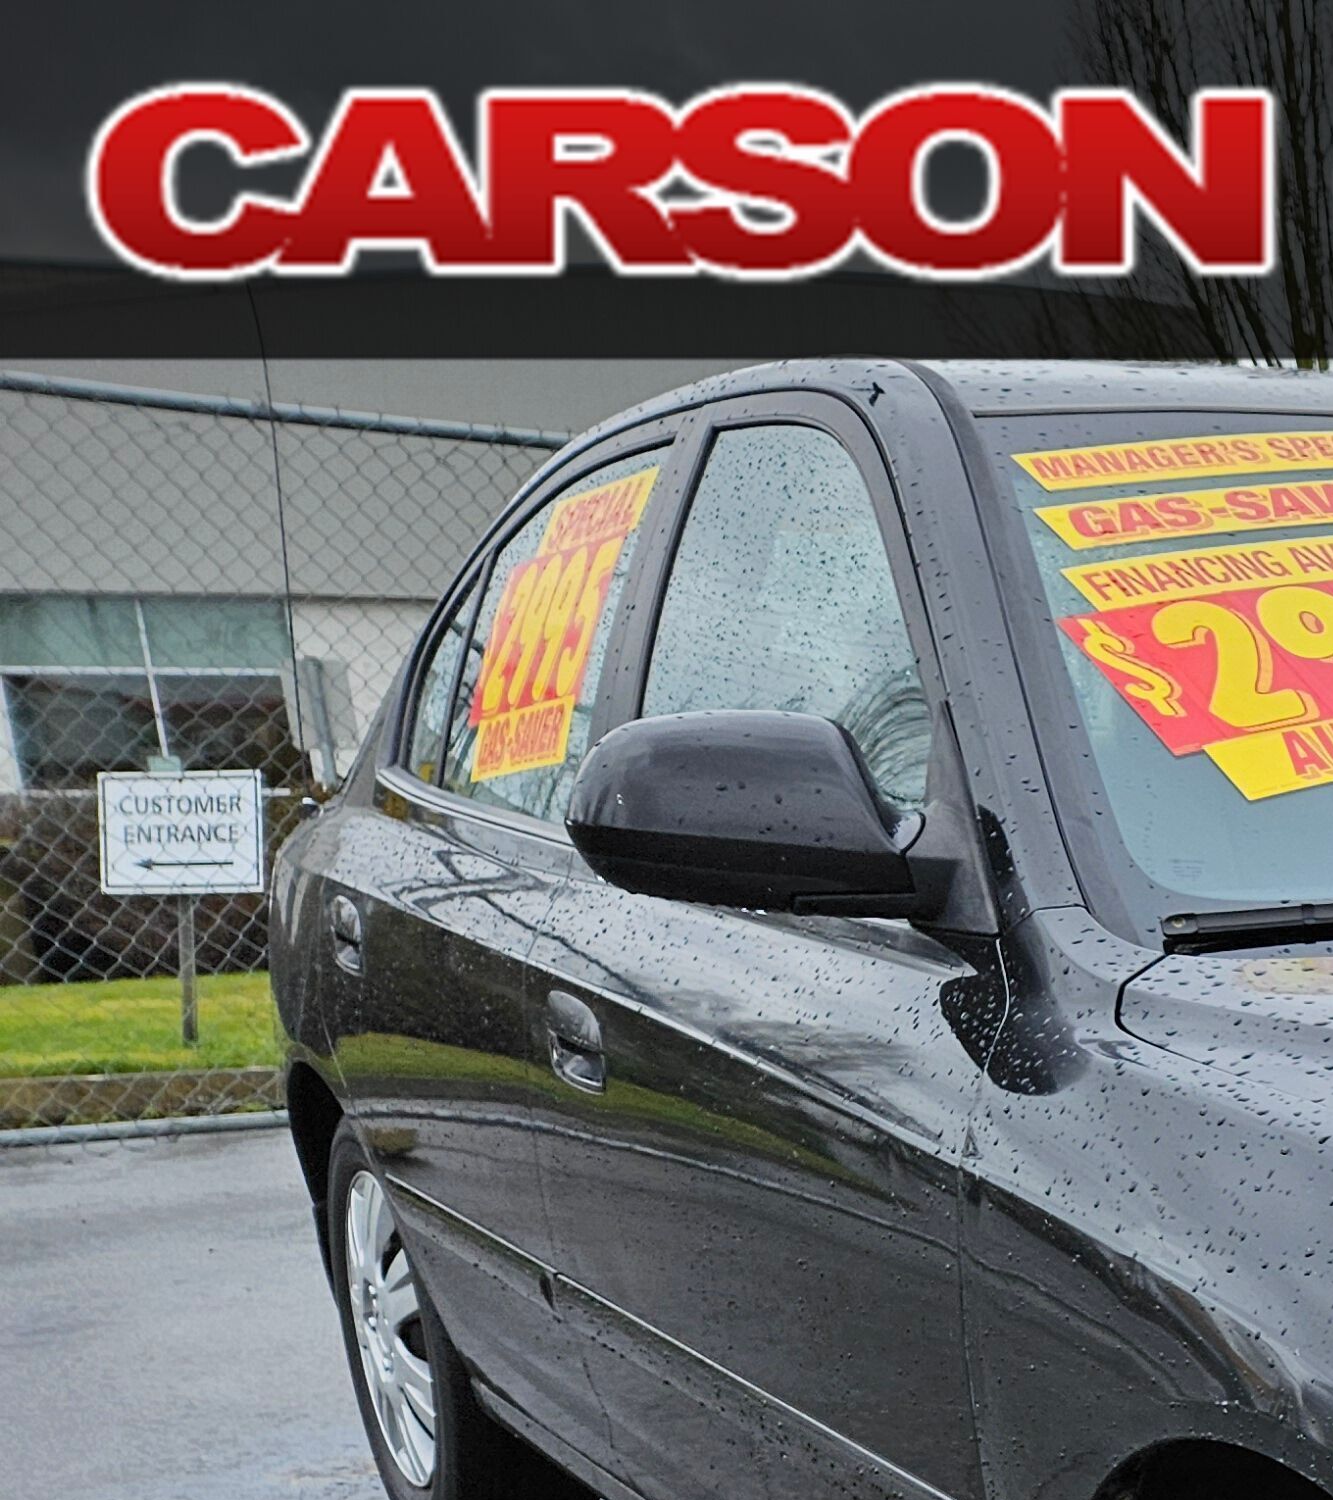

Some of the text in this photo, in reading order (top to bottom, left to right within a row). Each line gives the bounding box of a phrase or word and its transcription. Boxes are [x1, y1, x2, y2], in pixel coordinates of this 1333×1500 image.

[1031, 439, 1266, 482] MANAGER'S
[1081, 550, 1293, 601] FINANCING
[118, 795, 241, 815] CUSTOMER
[123, 824, 240, 844] ENTRANCE
